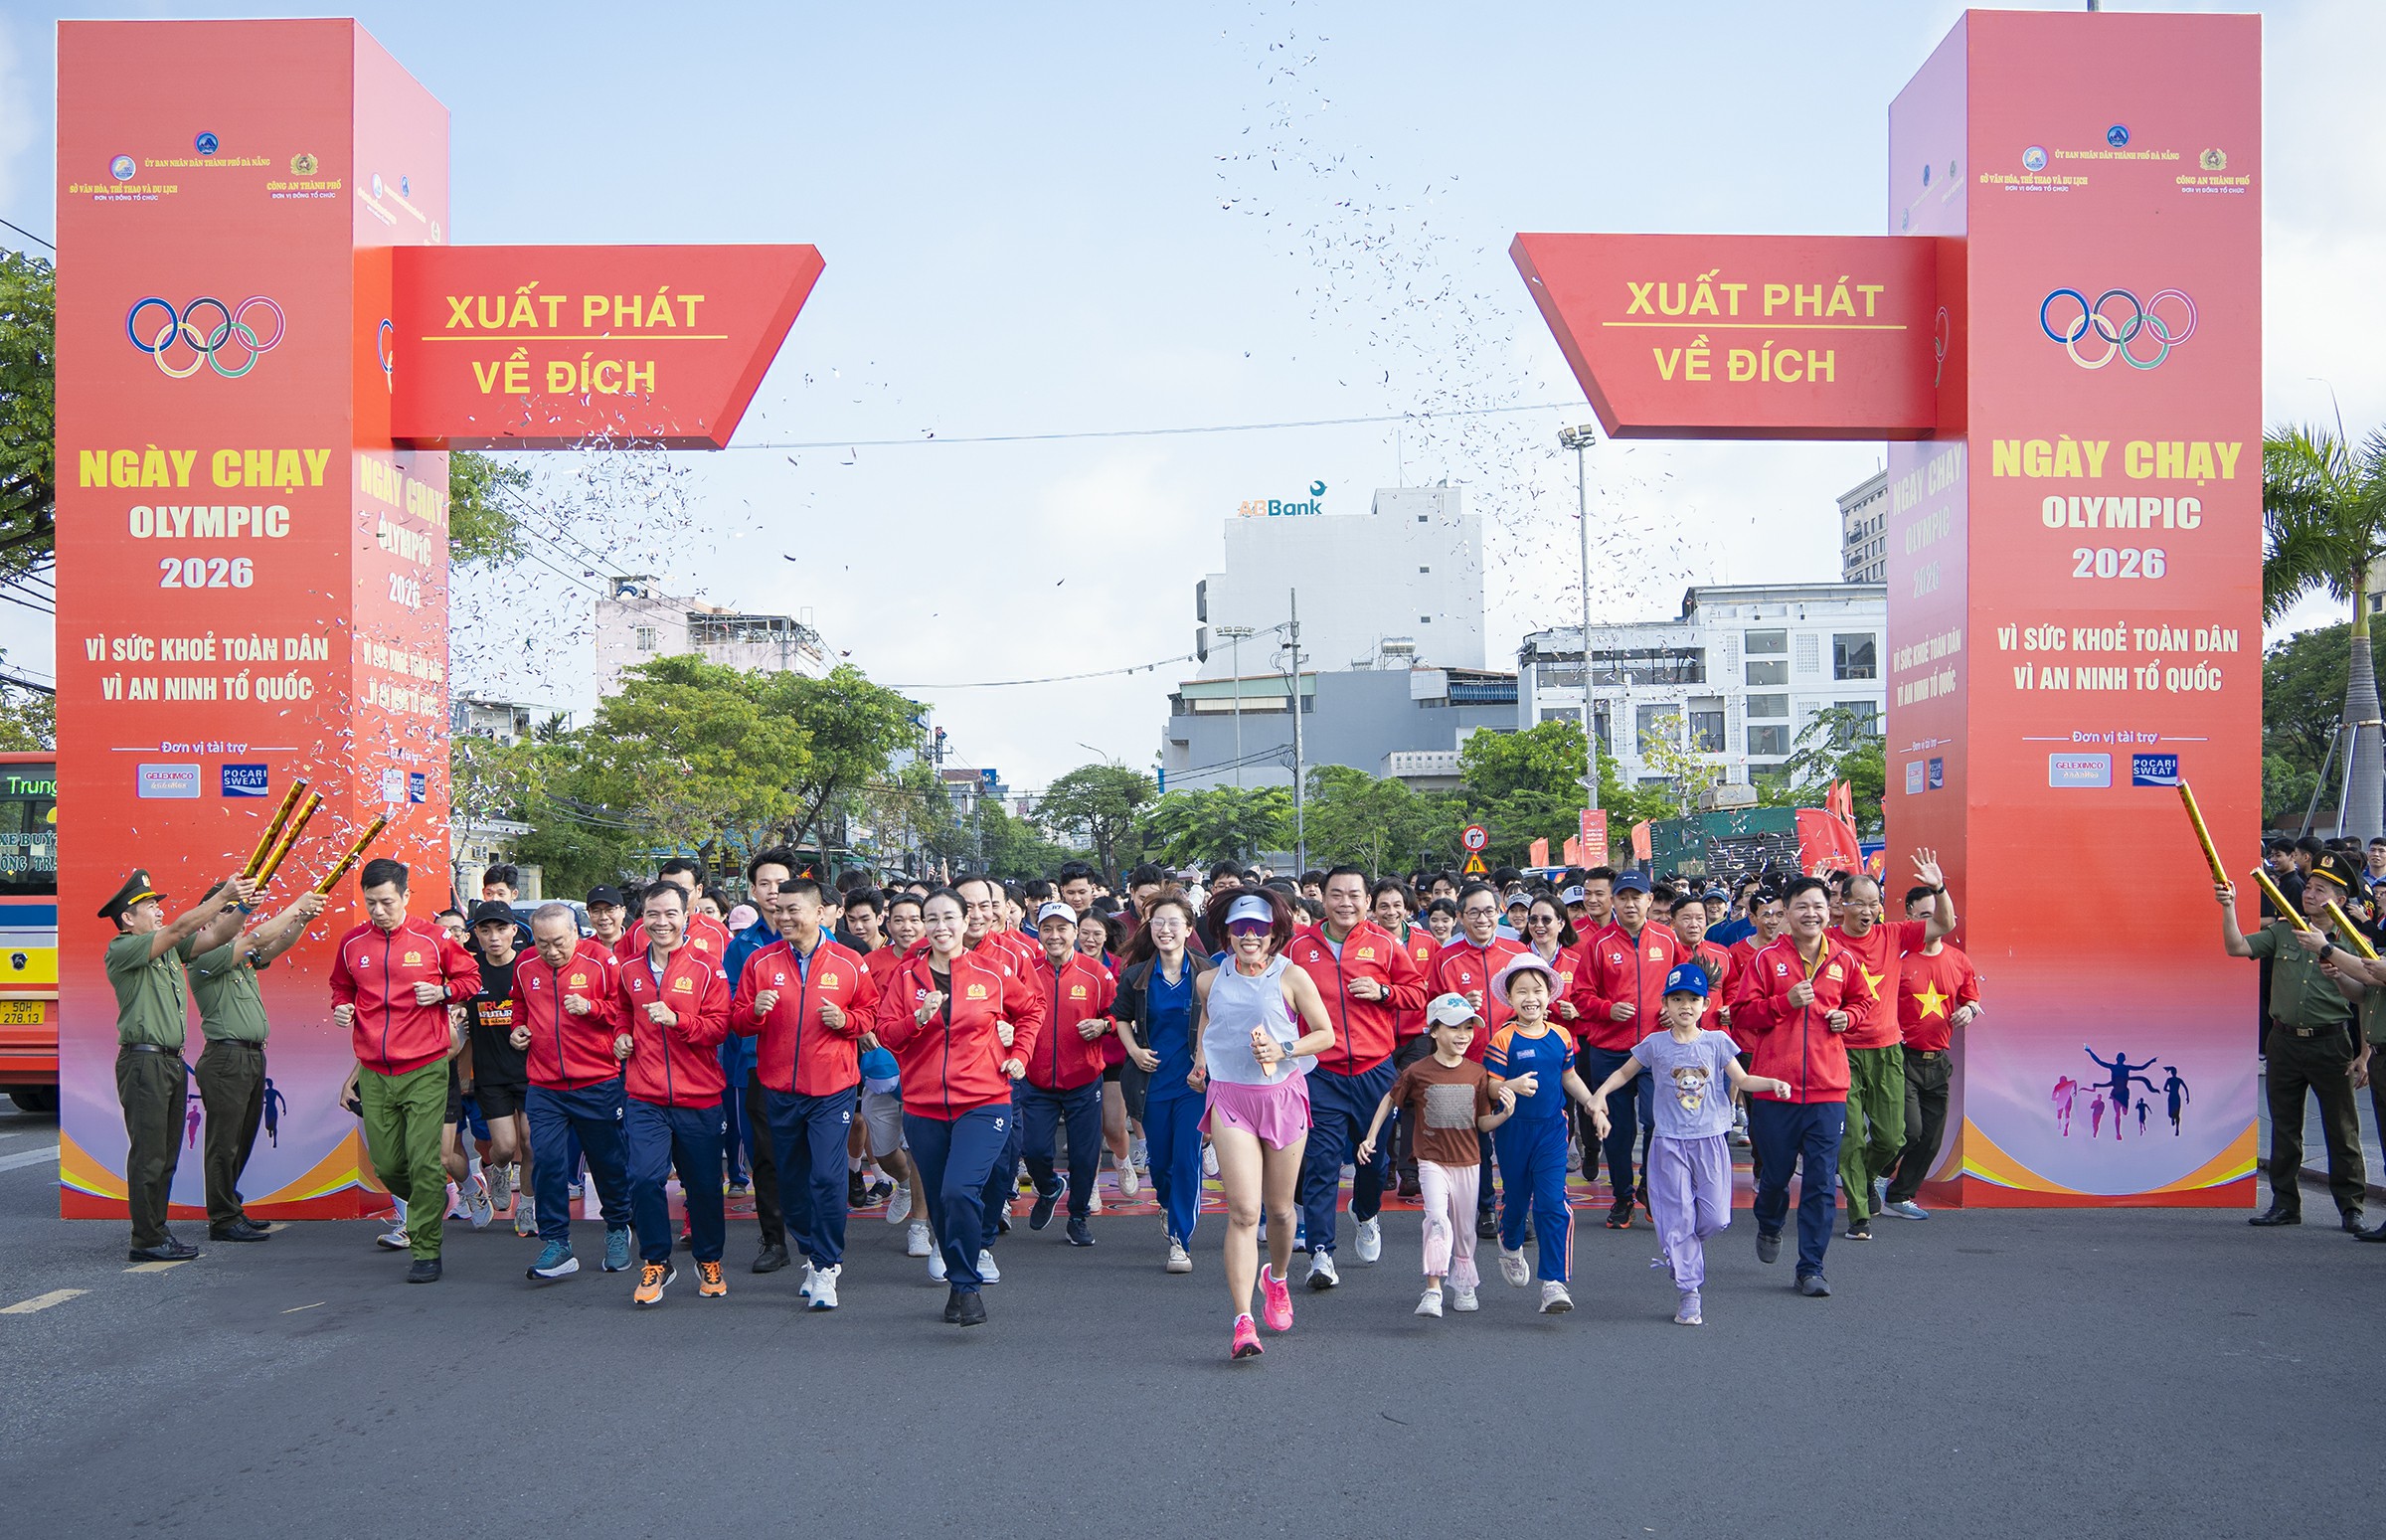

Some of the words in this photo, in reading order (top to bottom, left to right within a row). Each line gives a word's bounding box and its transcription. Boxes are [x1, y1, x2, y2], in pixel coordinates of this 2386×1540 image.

[205, 158, 226, 167] THÀNH
[228, 157, 241, 167] PHỐ
[2137, 150, 2149, 159] PHỐ
[142, 184, 151, 193] VÀ
[267, 181, 286, 190] CÔNG
[301, 181, 325, 190] THÀNH
[327, 179, 341, 190] PHỐ
[2053, 175, 2062, 184] VÀ
[2176, 175, 2195, 184] CÔNG
[2210, 176, 2234, 185] THÀNH
[2236, 175, 2250, 185] PHỐ
[445, 281, 567, 328] XUẤT
[584, 286, 705, 327] PHÁT
[1626, 269, 1748, 316] XUẤT
[1764, 275, 1884, 317] PHÁT
[472, 347, 530, 394] VỀ
[547, 352, 654, 394] ĐÍCH
[1652, 335, 1711, 381] VỀ
[1727, 341, 1835, 382] ĐÍCH
[80, 444, 197, 488] NGÀY
[212, 448, 331, 494] CHẠY
[1992, 434, 2108, 478] NGÀY
[2125, 441, 2242, 485] CHẠY
[361, 454, 402, 508] NGÀY
[406, 478, 443, 528] CHẠY
[1894, 467, 1924, 517] NGÀY
[1928, 442, 1962, 496] CHẠY
[129, 505, 289, 538] OLYMPIC
[1238, 499, 1322, 516] ABBank
[2042, 496, 2201, 529] OLYMPIC
[378, 519, 431, 568] OLYMPIC
[1906, 505, 1950, 556] OLYMPIC
[159, 558, 254, 589] 2026
[1914, 560, 1940, 599] 2026
[2072, 548, 2166, 579] 2026
[390, 573, 421, 608] 2026
[85, 634, 105, 661] VÌ
[112, 632, 154, 662] SỨC
[161, 630, 216, 661] KHOẺ
[223, 632, 280, 661] TOÀN
[287, 633, 328, 661] DÂN
[364, 639, 371, 664] VÌ
[1894, 647, 1900, 673] VÌ
[1901, 643, 1912, 670] SỨC
[1931, 628, 1947, 660] TOÀN
[1948, 627, 1960, 653] DÂN
[1997, 624, 2017, 651] VÌ
[2024, 623, 2066, 652] SỨC
[2073, 621, 2127, 652] KHOẺ
[2133, 624, 2190, 652] TOÀN
[2195, 624, 2239, 652] DÂN
[101, 673, 122, 701] VÌ
[128, 677, 158, 700] AN
[165, 677, 217, 700] NINH
[223, 669, 250, 700] TỔ
[256, 669, 313, 702] QUỐC
[1898, 681, 1903, 707] VÌ
[1905, 684, 1913, 705] AN
[1914, 678, 1929, 702] NINH
[1931, 667, 1938, 698] TỔ
[1940, 663, 1956, 696] QUỐC
[2013, 663, 2034, 691] VÌ
[2040, 667, 2070, 690] AN
[2076, 667, 2127, 690] NINH
[2133, 659, 2160, 691] TỔ
[2166, 660, 2222, 693] QUỐC
[161, 742, 189, 753] Đơn
[192, 742, 204, 755] vị
[207, 741, 224, 753] tài
[227, 743, 247, 755] trợ
[2073, 731, 2100, 743] Đơn
[2104, 731, 2115, 745] vị
[2118, 731, 2133, 743] tài
[2137, 732, 2158, 745] trợ
[0, 854, 27, 871] ƠNG
[4, 1013, 39, 1023] 278.13
[13, 1002, 32, 1012] 50H
